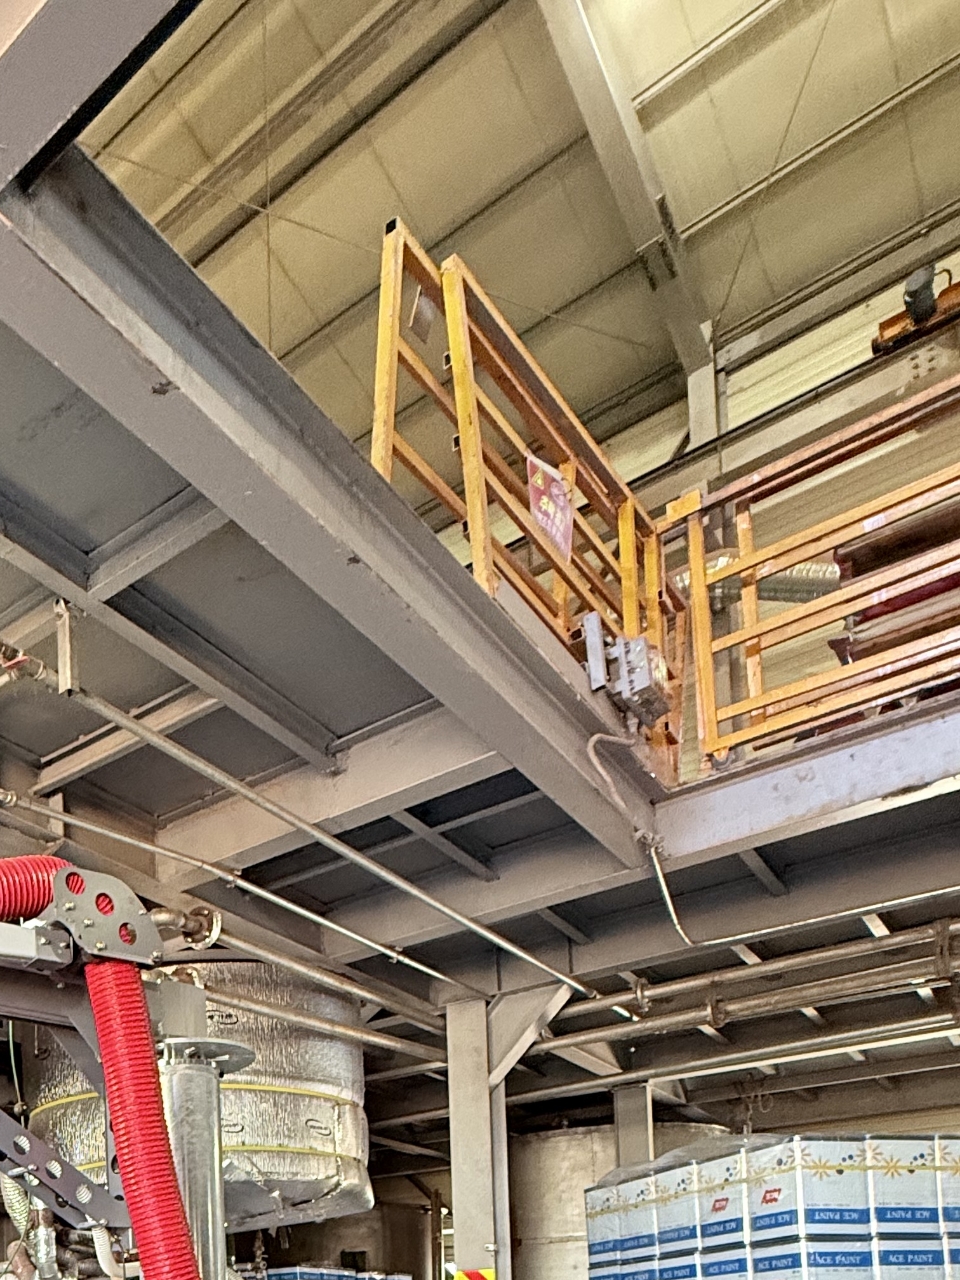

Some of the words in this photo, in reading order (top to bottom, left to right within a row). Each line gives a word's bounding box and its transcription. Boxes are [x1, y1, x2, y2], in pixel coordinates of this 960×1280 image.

[814, 1211, 840, 1220] PAINT
[842, 1211, 859, 1220] ACE
[885, 1210, 912, 1219] PAINT
[915, 1210, 930, 1218] ACE
[889, 1254, 905, 1263] ACE
[907, 1254, 933, 1263] PAINT
[757, 1261, 771, 1269] ACE
[772, 1258, 792, 1267] PAINT
